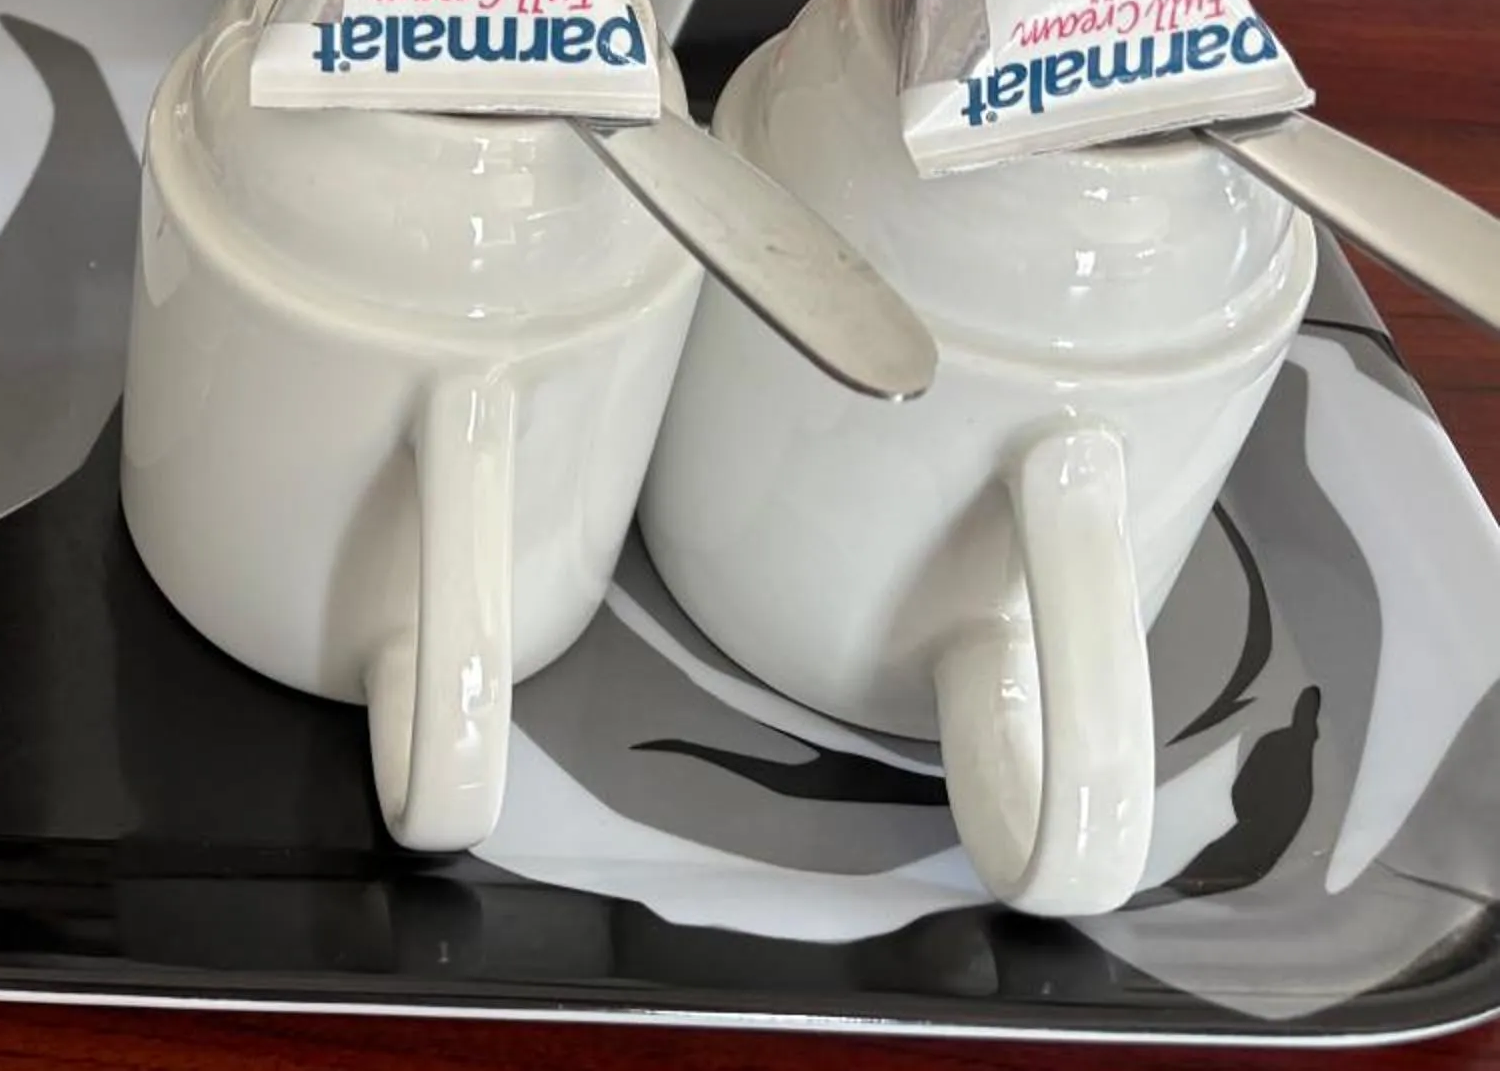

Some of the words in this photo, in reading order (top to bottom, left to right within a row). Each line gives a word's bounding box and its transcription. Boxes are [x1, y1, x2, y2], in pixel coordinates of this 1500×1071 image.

[312, 4, 648, 73] parmalat
[1010, 2, 1142, 50] Cream
[960, 16, 1280, 127] parmalat
